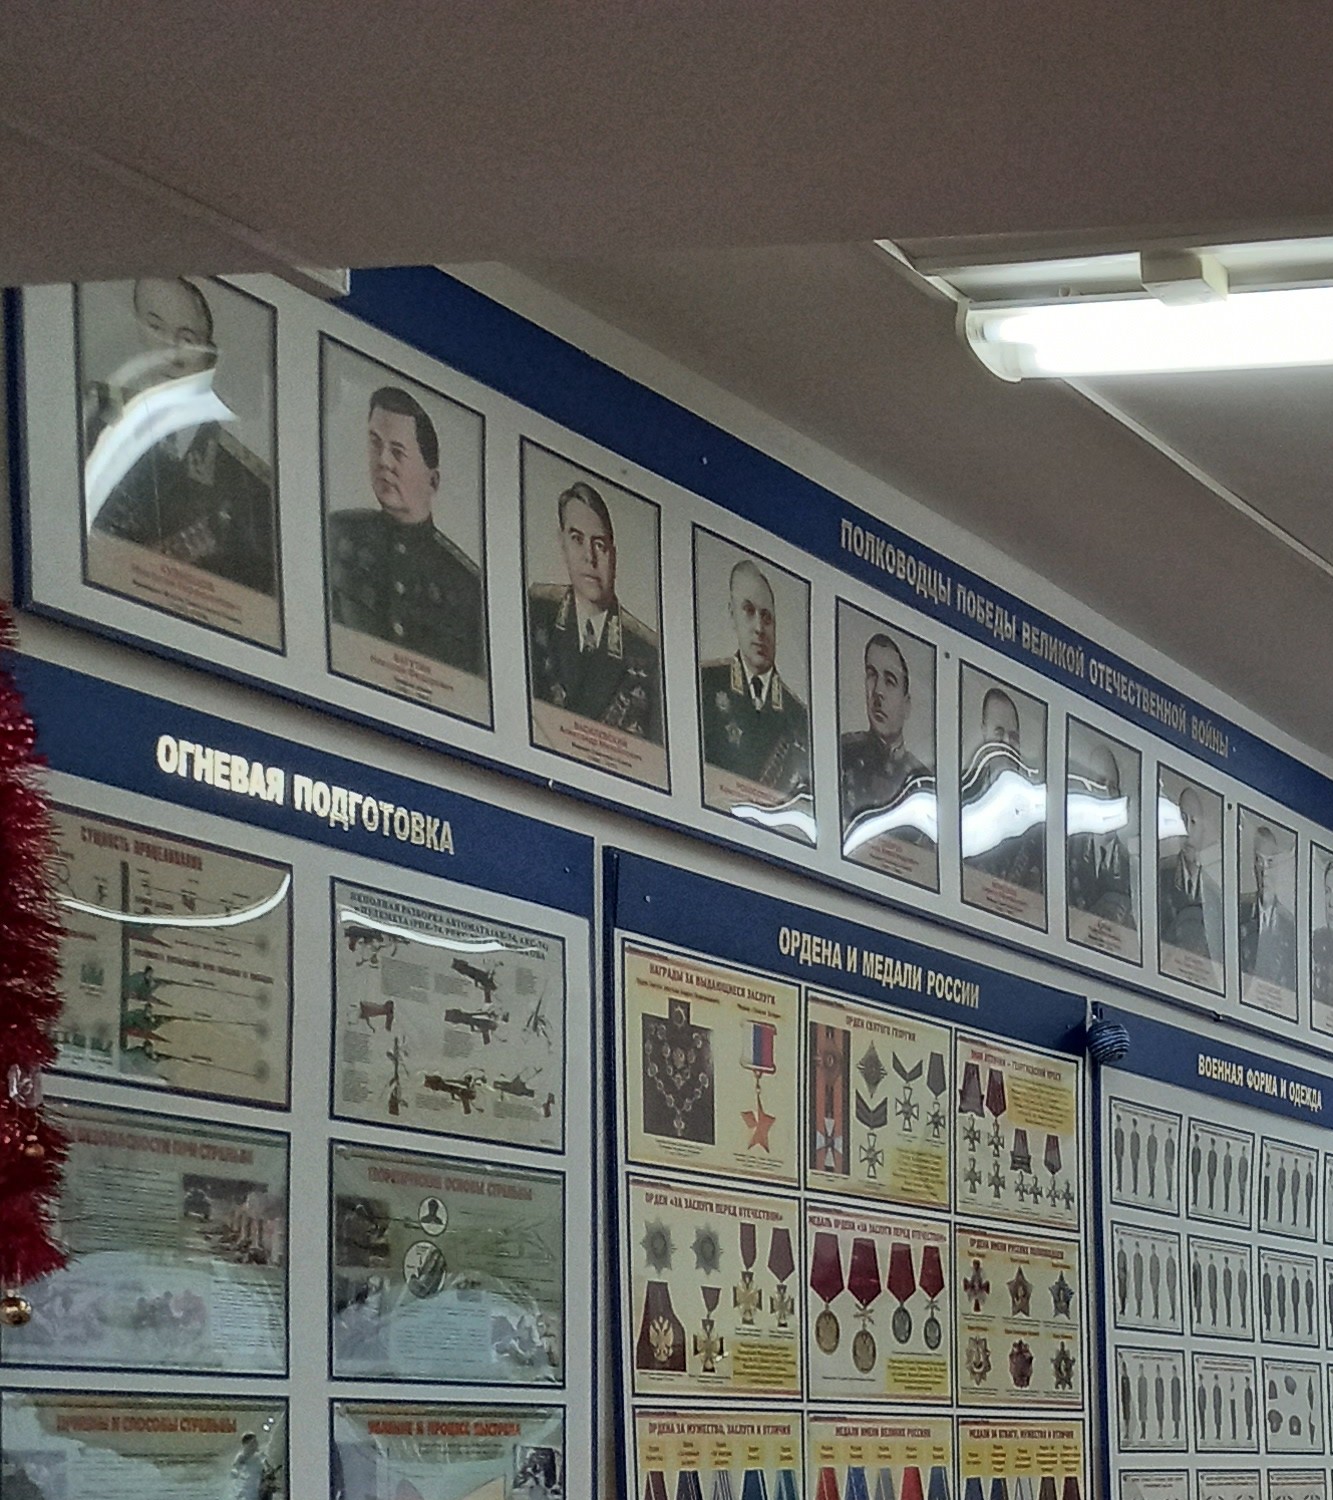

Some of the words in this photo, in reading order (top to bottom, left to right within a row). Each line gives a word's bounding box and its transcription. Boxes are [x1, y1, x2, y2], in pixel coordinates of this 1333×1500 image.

[840, 518, 951, 606] ПОЛКОВОДЦЫ
[957, 583, 1016, 641] ПОБЕДЫ
[1021, 620, 1085, 680] ВЕЛИКОЙ
[1089, 658, 1187, 734] ОТЕЧЕСТВЕННОЙ
[1191, 719, 1229, 758] ВОЙНЫ
[156, 734, 285, 805] ОГНЕВАЯ
[293, 774, 455, 855] ПОДГОТОВКА
[778, 926, 842, 970] ОРДЕНА
[847, 945, 857, 973] И
[862, 950, 922, 992] МЕДАЛИ
[927, 970, 979, 1009] РОССИИ
[1198, 1053, 1243, 1087] ВОЕННАЯ
[1246, 1068, 1278, 1096] ФОРМА
[1280, 1078, 1287, 1099] И
[1289, 1081, 1322, 1112] ОДЕЖДА
